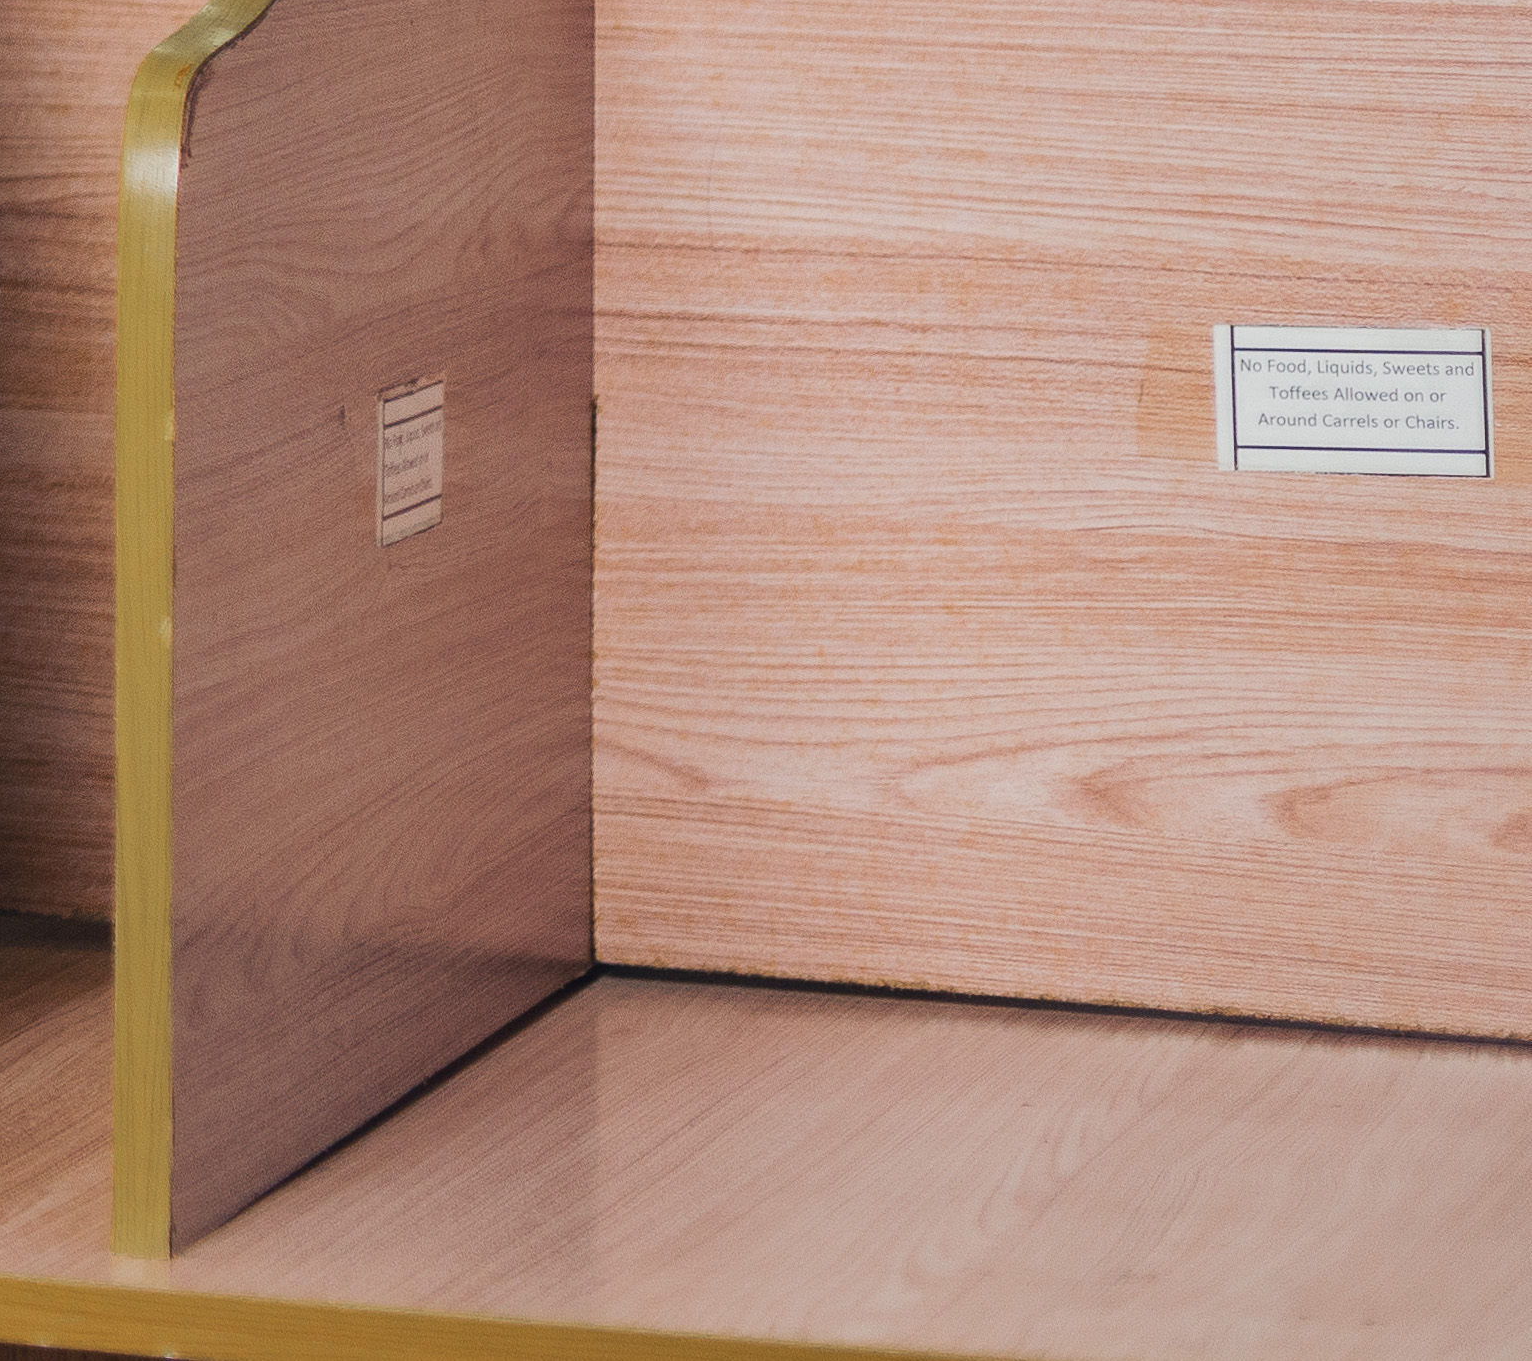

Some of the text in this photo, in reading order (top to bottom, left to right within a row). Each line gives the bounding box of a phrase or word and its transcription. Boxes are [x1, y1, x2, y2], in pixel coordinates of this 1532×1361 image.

[1240, 359, 1475, 377] No Food, Liquids, Sweets and
[1269, 385, 1447, 403] Toffees Allowed on or
[1258, 412, 1460, 430] Around Carrels or Chairs.
